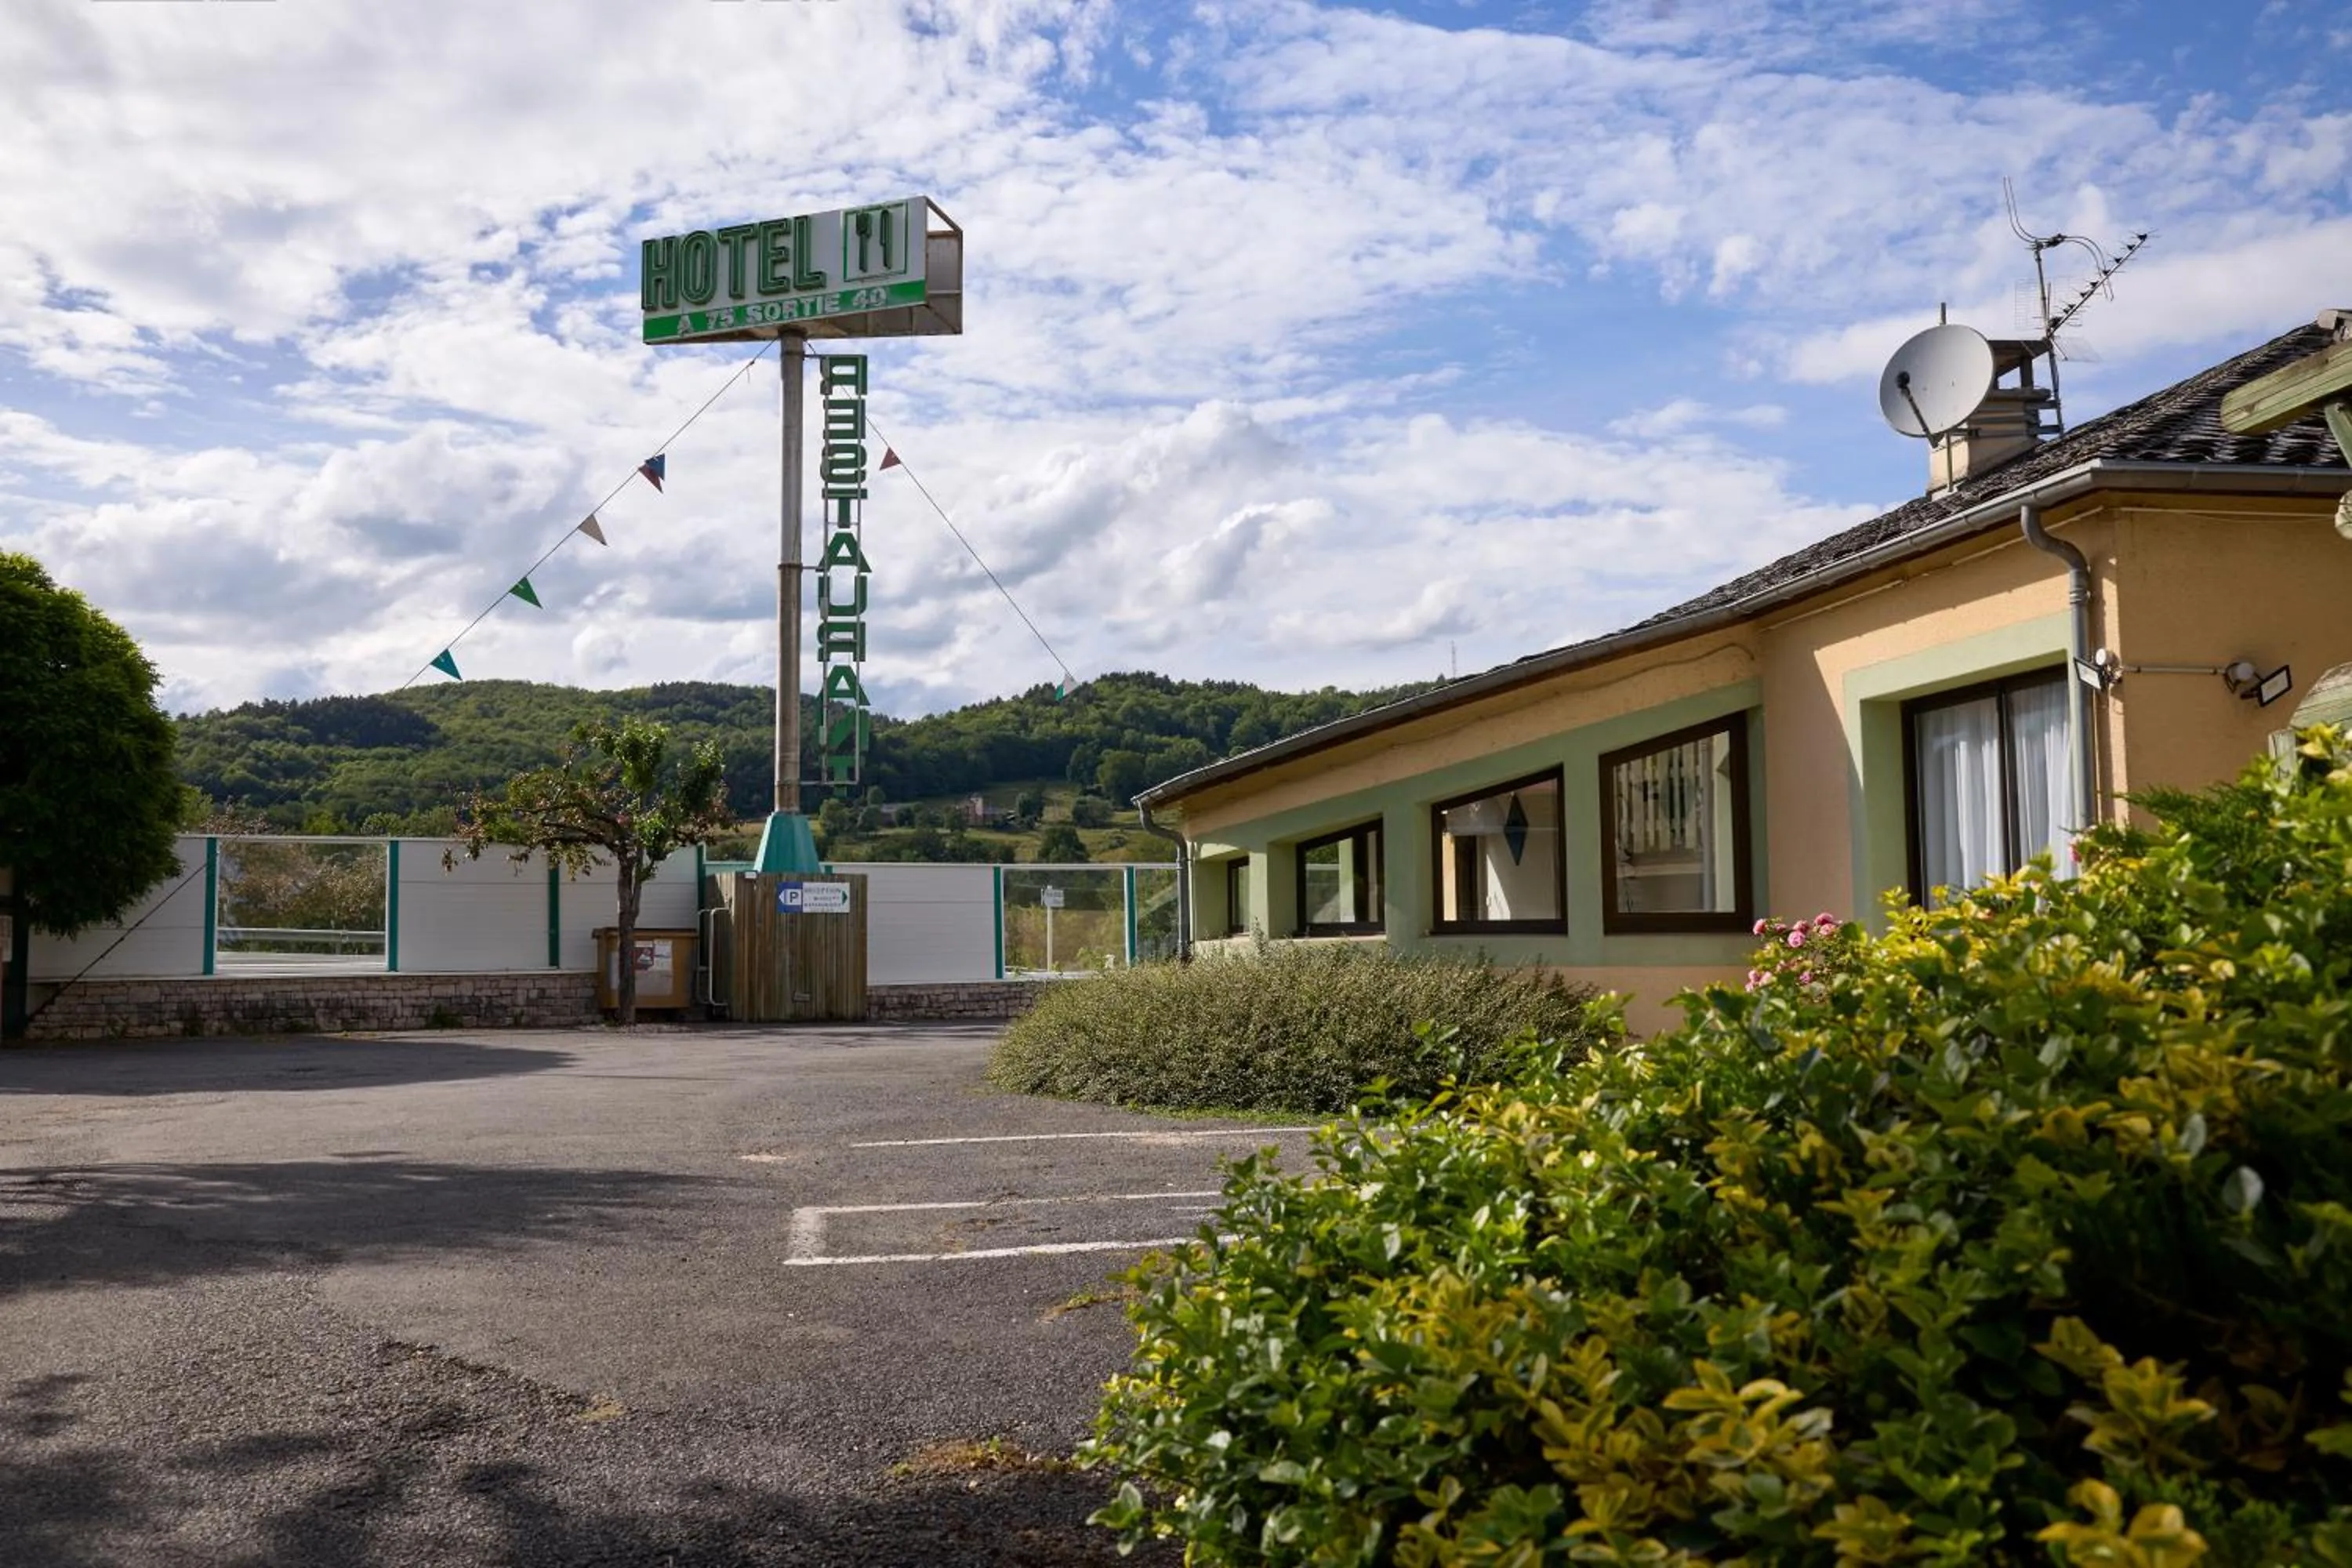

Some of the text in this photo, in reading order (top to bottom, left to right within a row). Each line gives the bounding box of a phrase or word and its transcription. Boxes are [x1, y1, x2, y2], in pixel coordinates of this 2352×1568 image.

[641, 216, 826, 310] HOTEL
[677, 314, 694, 337] A
[706, 307, 735, 330] 75
[746, 292, 840, 322] SORTIE
[789, 891, 799, 903] P
